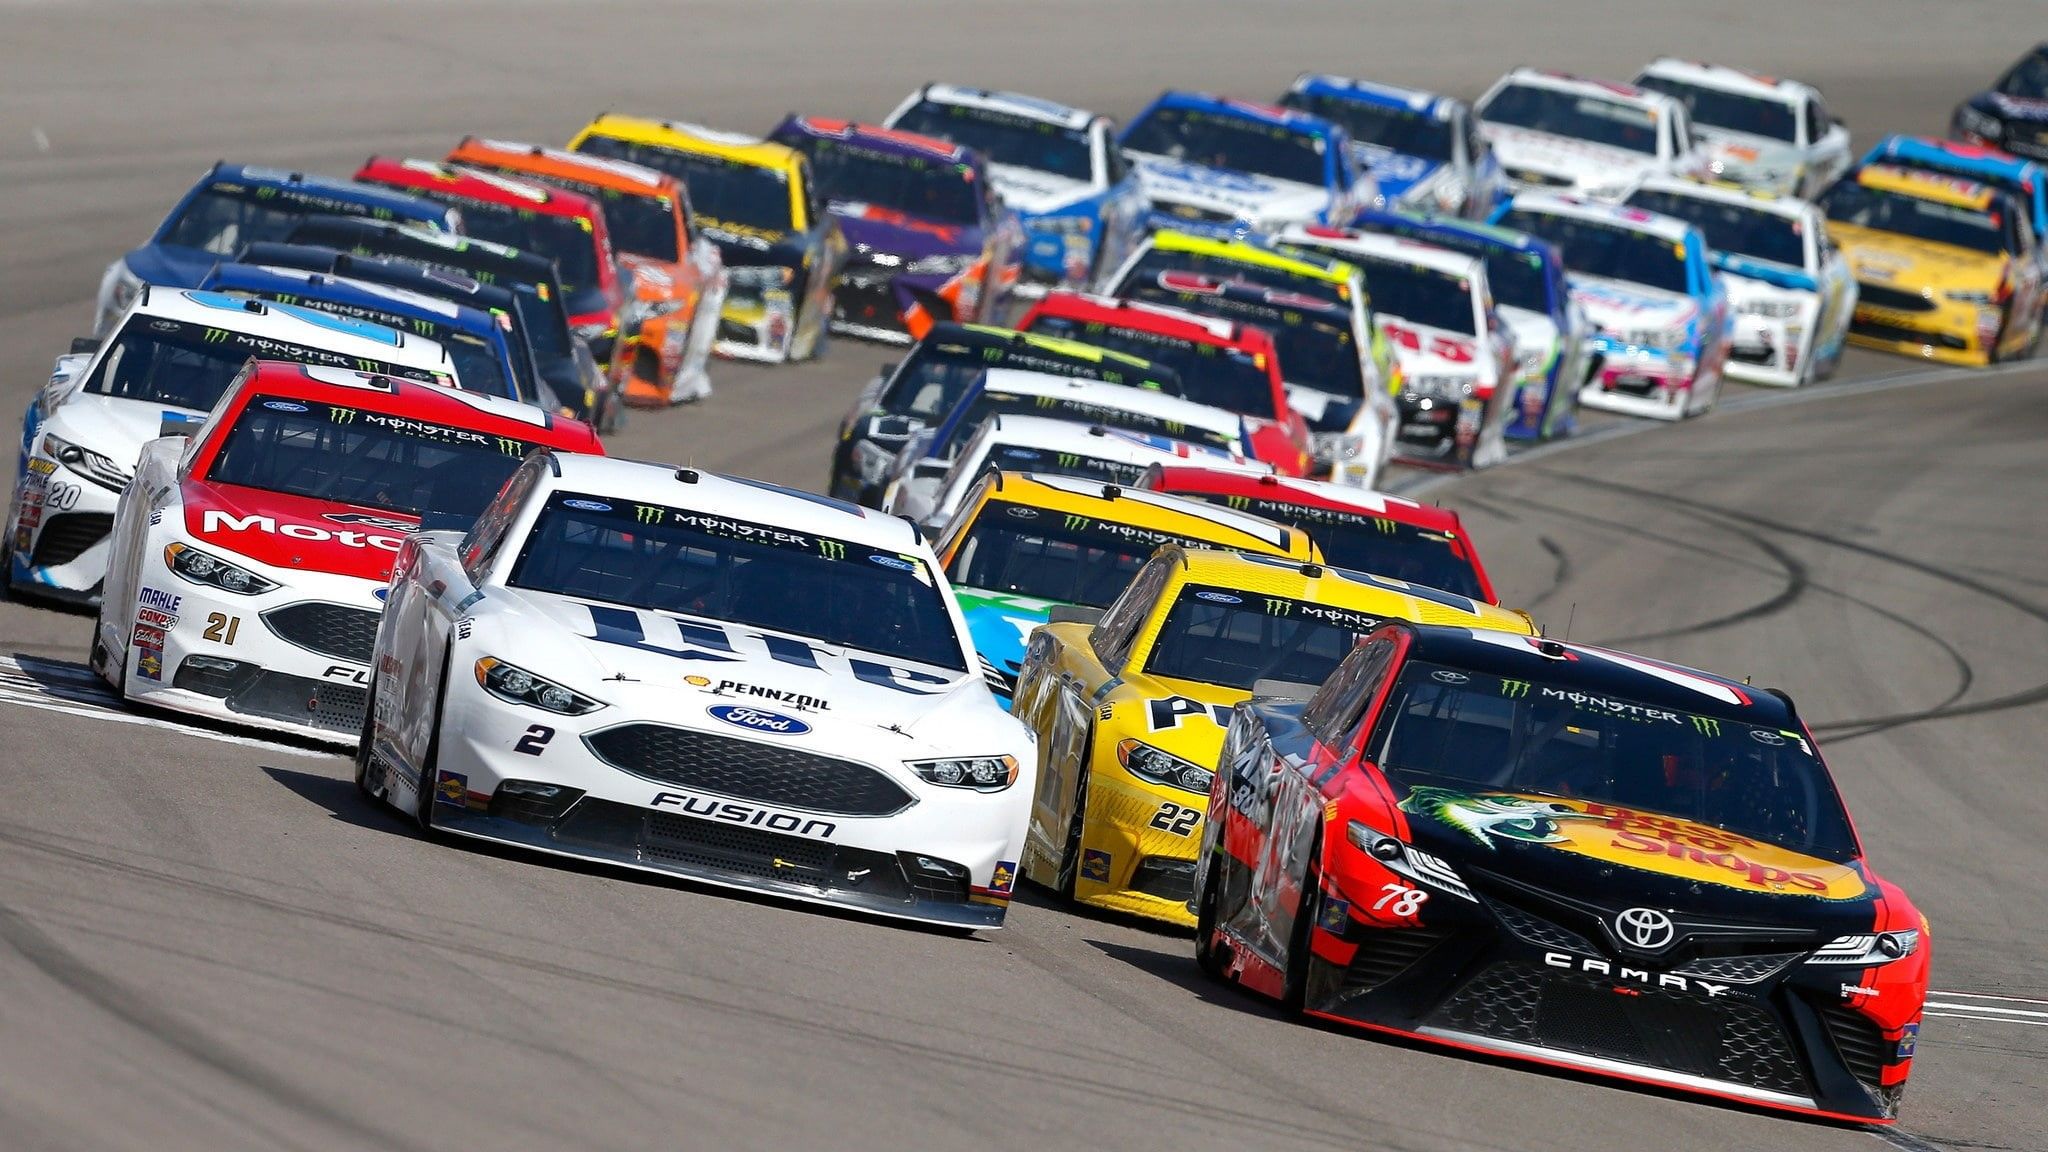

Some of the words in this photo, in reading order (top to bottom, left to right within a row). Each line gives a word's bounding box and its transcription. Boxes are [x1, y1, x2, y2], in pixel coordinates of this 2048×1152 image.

[303, 299, 408, 328] MONSTER
[236, 335, 350, 366] MONSTER
[365, 413, 489, 446] MONSTER
[46, 480, 82, 511] 20
[1258, 500, 1368, 526] MONSTER
[674, 512, 810, 548] MONSTER
[705, 529, 780, 547] ENERGY
[1098, 522, 1213, 550] MONSTER
[138, 586, 182, 612] MAHLE
[138, 609, 168, 625] COMP
[202, 611, 241, 646] 21
[719, 679, 832, 711] PENNZOIL
[1541, 686, 1684, 725] MONSTER
[726, 707, 790, 731] Ford
[1575, 705, 1653, 724] ENERGY
[513, 724, 556, 756] 2
[650, 791, 837, 838] FUSION
[1149, 800, 1202, 839] 22
[1610, 830, 1830, 891] Shops
[1372, 883, 1430, 917] 78
[1545, 951, 1731, 998] CAMRY
